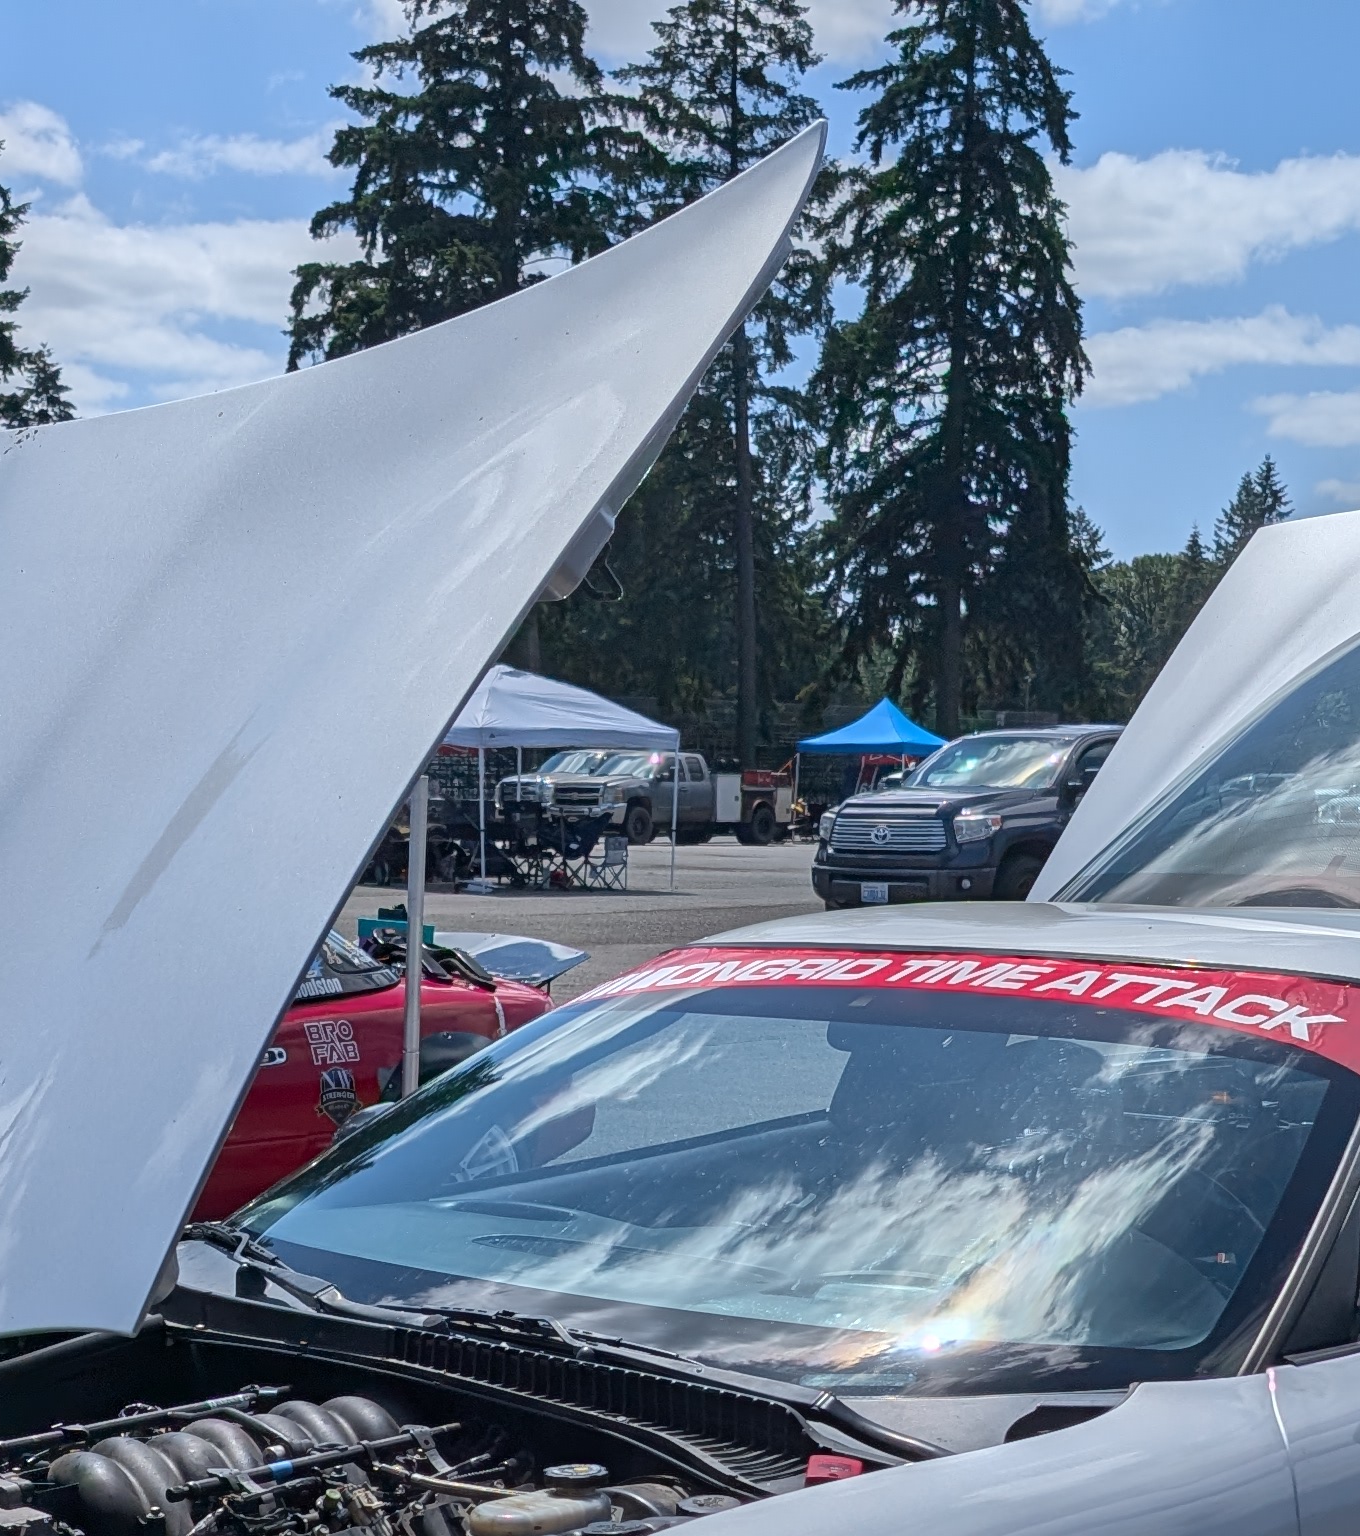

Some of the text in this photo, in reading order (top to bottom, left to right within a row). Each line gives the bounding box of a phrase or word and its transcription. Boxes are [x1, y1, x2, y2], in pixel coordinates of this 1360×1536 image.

[886, 958, 1056, 991] TIME
[1033, 968, 1347, 1042] ATTACK
[304, 1019, 353, 1044] BRO
[311, 1041, 360, 1065] FAB
